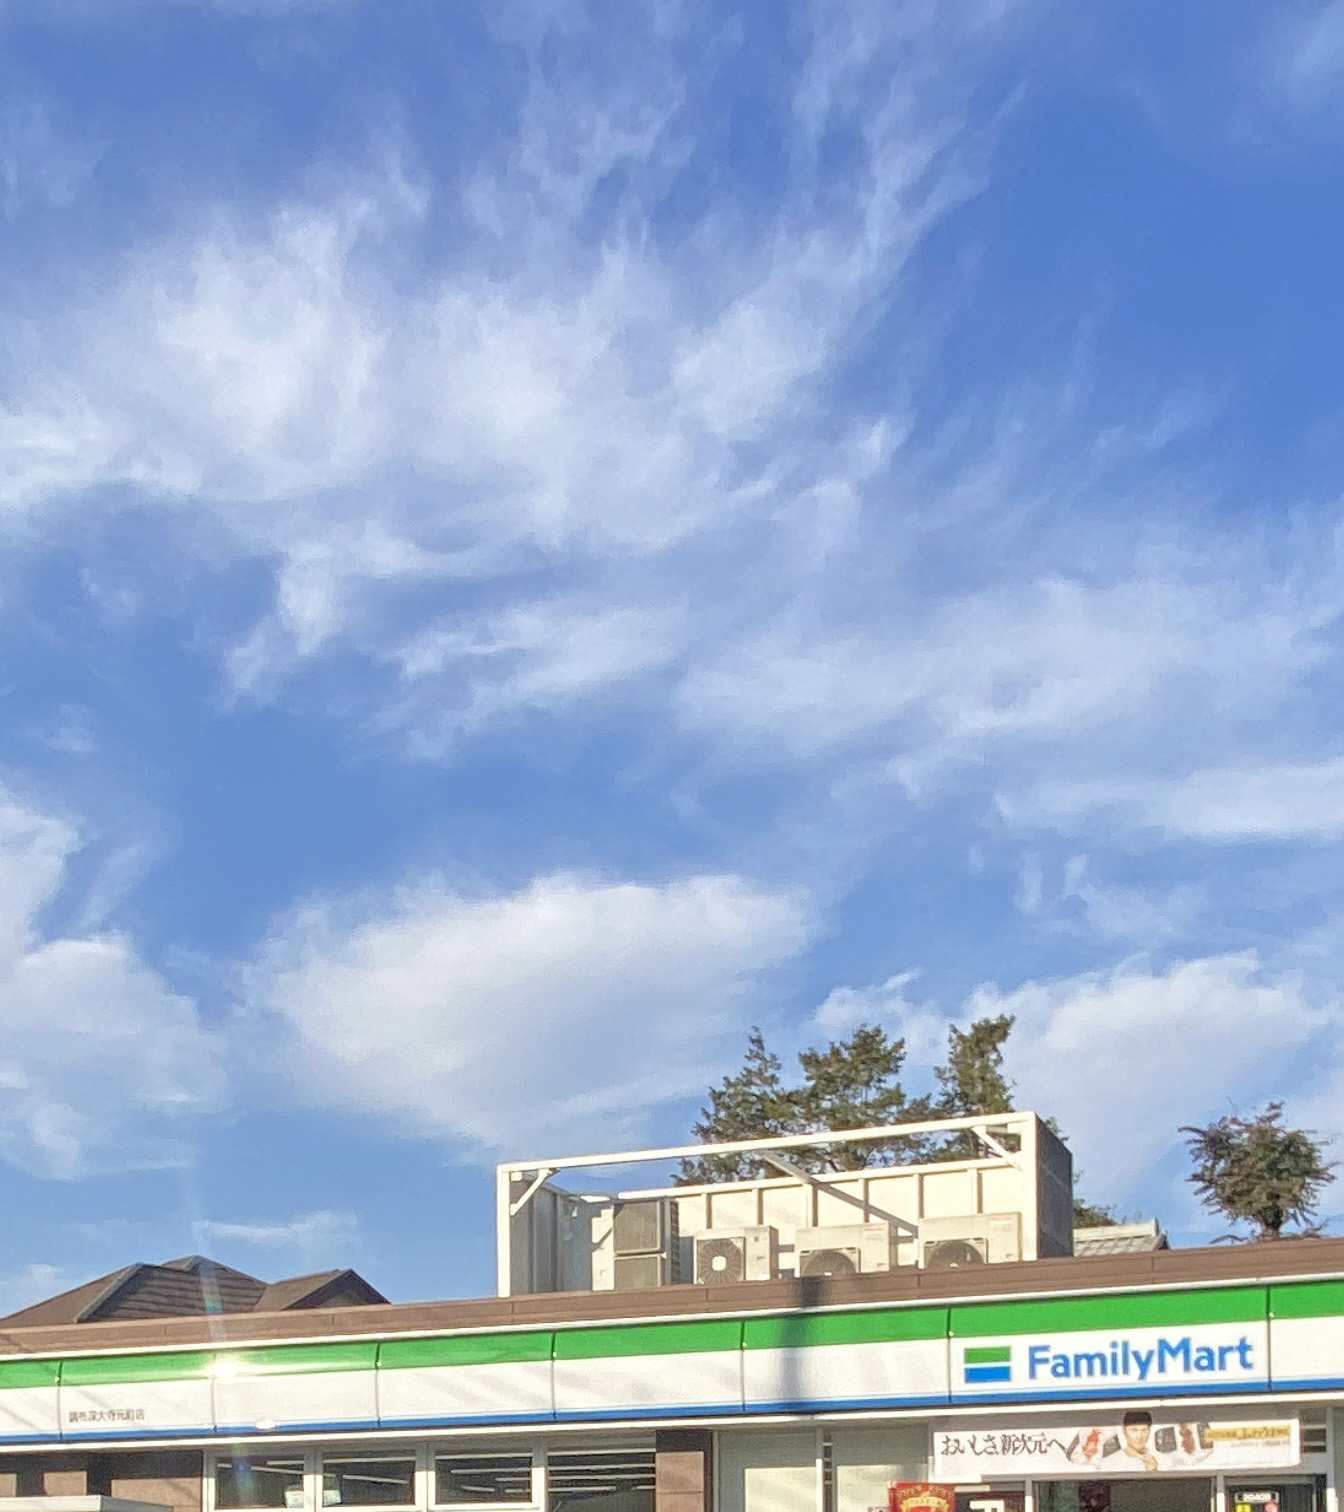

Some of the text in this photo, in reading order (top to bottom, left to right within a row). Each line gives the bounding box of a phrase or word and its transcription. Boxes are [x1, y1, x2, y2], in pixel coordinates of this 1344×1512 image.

[1028, 1336, 1253, 1380] FamilyMart
[941, 1432, 1067, 1456] おいしさ新次元へ
